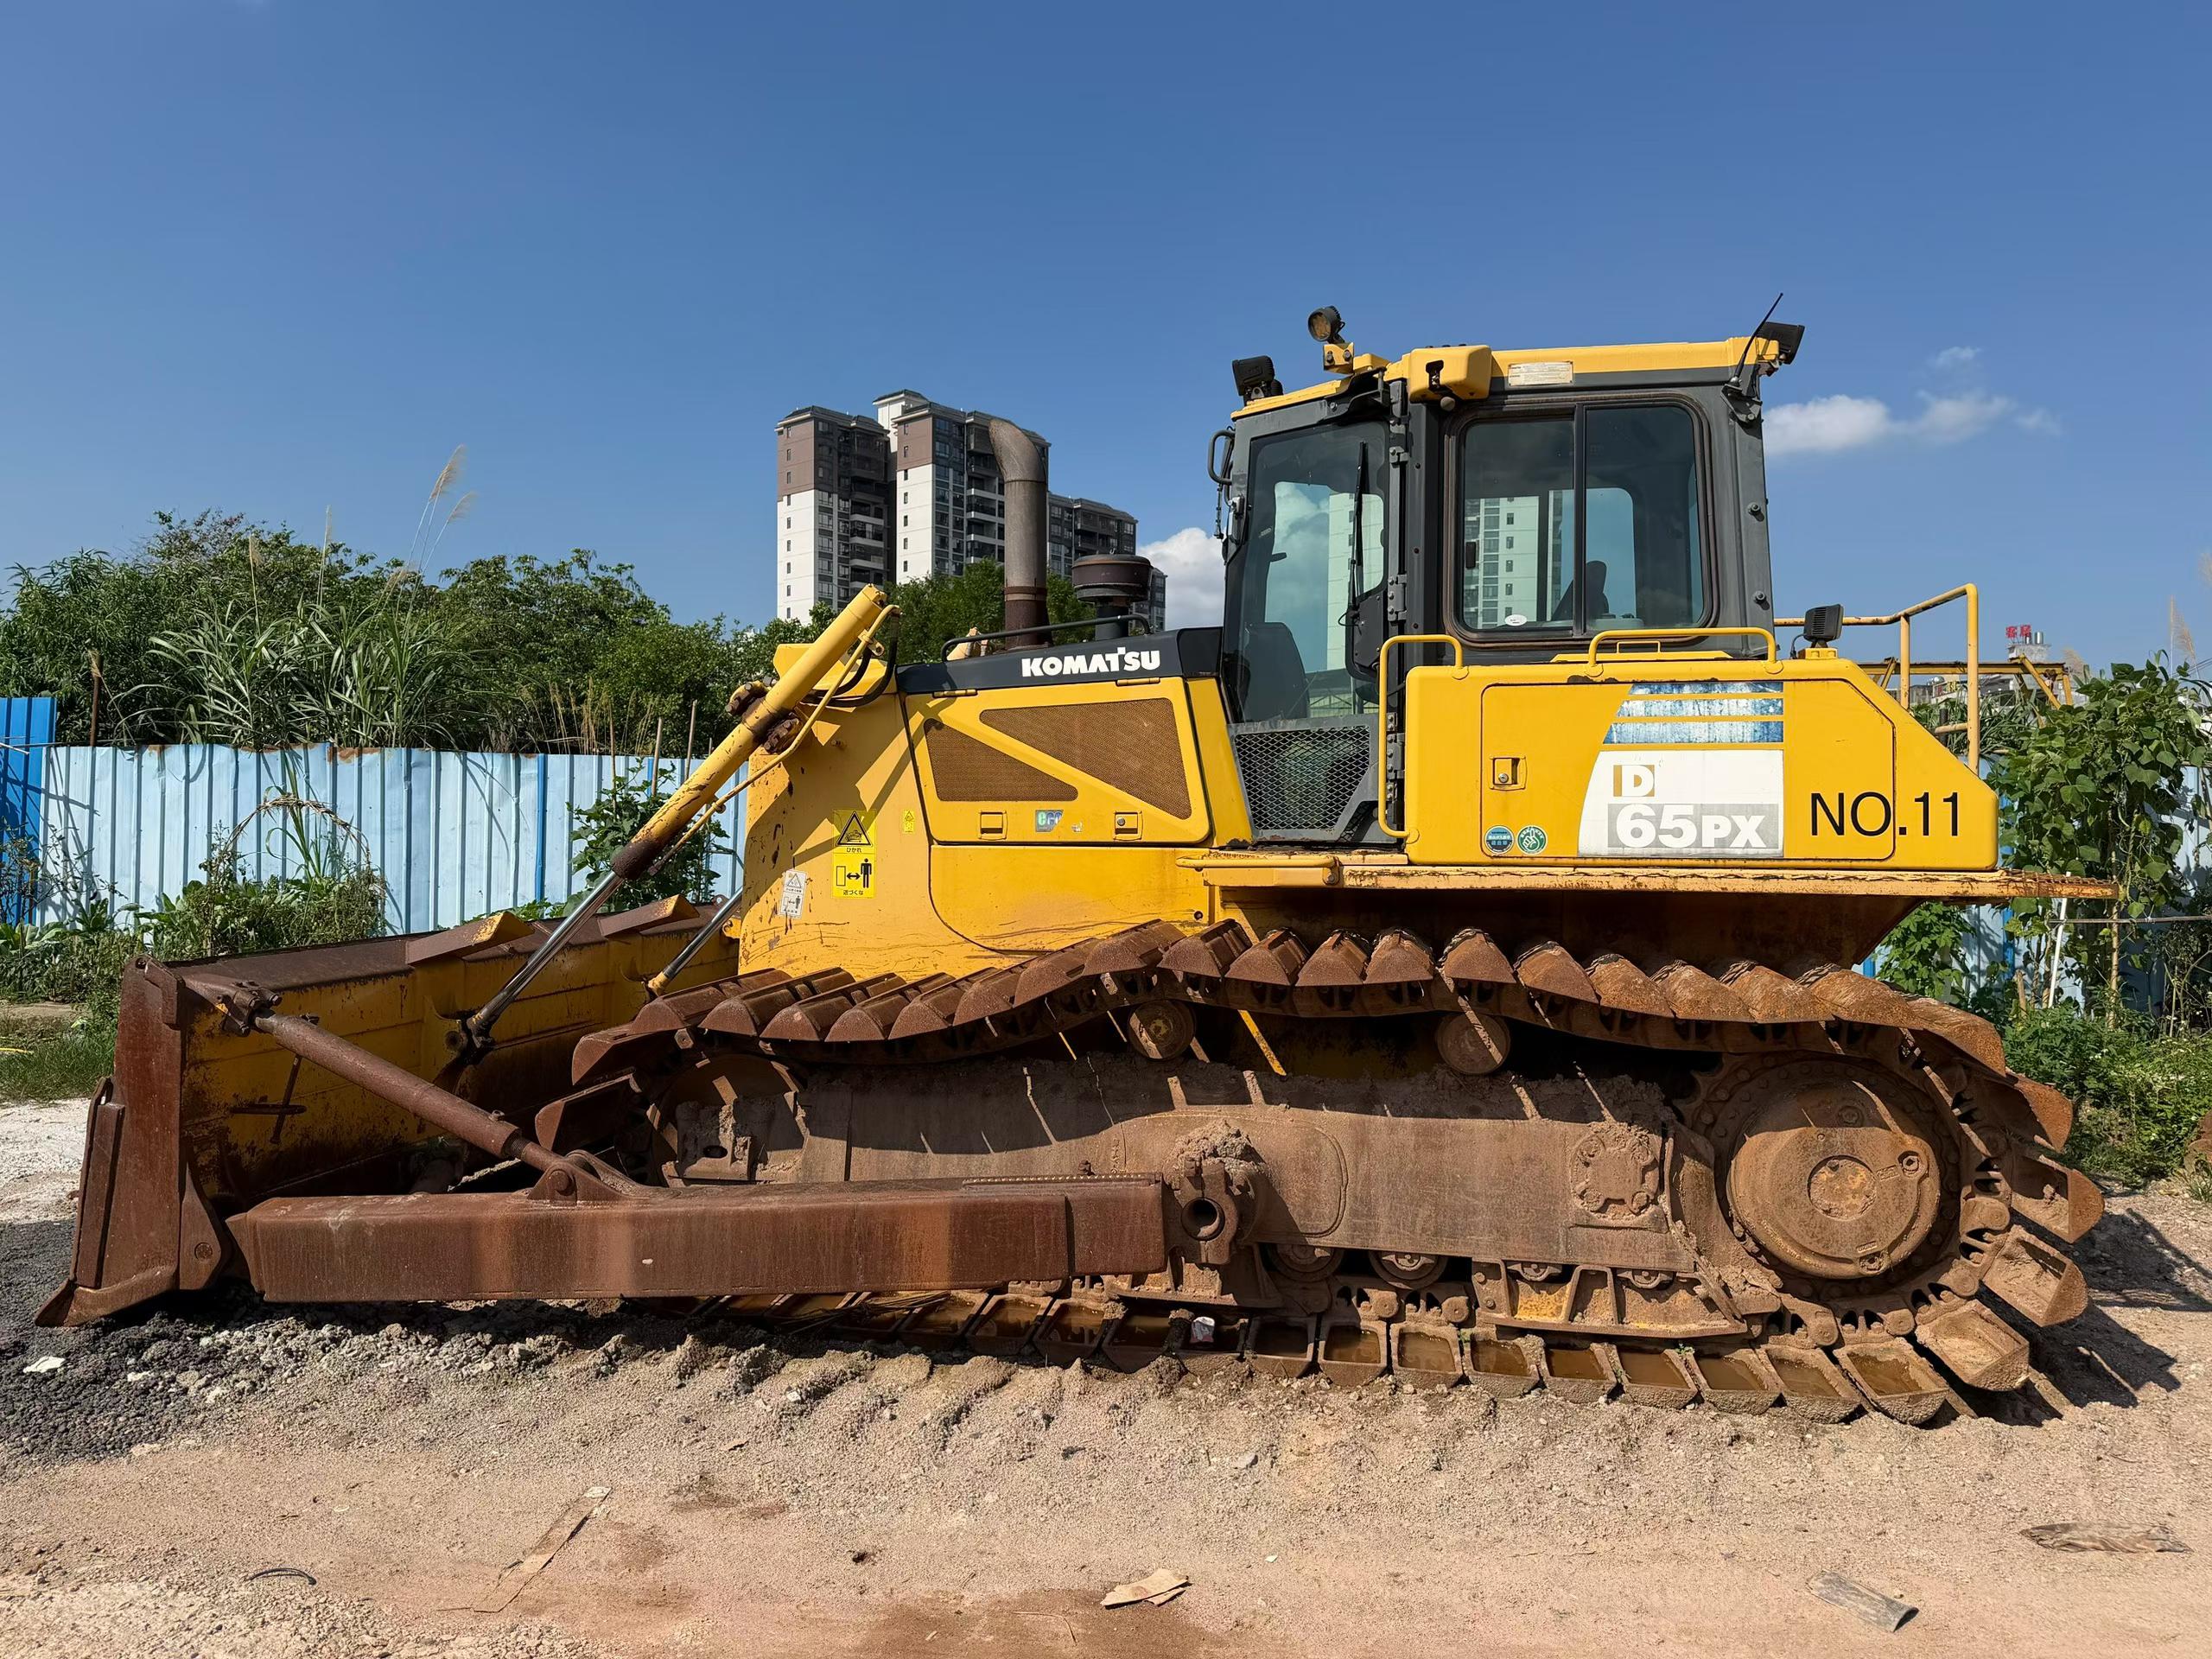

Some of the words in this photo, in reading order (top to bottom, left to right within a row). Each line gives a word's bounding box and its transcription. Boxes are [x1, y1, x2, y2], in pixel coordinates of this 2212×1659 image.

[1021, 647, 1160, 677] KOMATSU
[1622, 765, 1654, 796] D
[1616, 804, 1767, 848] 65PX
[1811, 791, 1958, 836] NO.11
